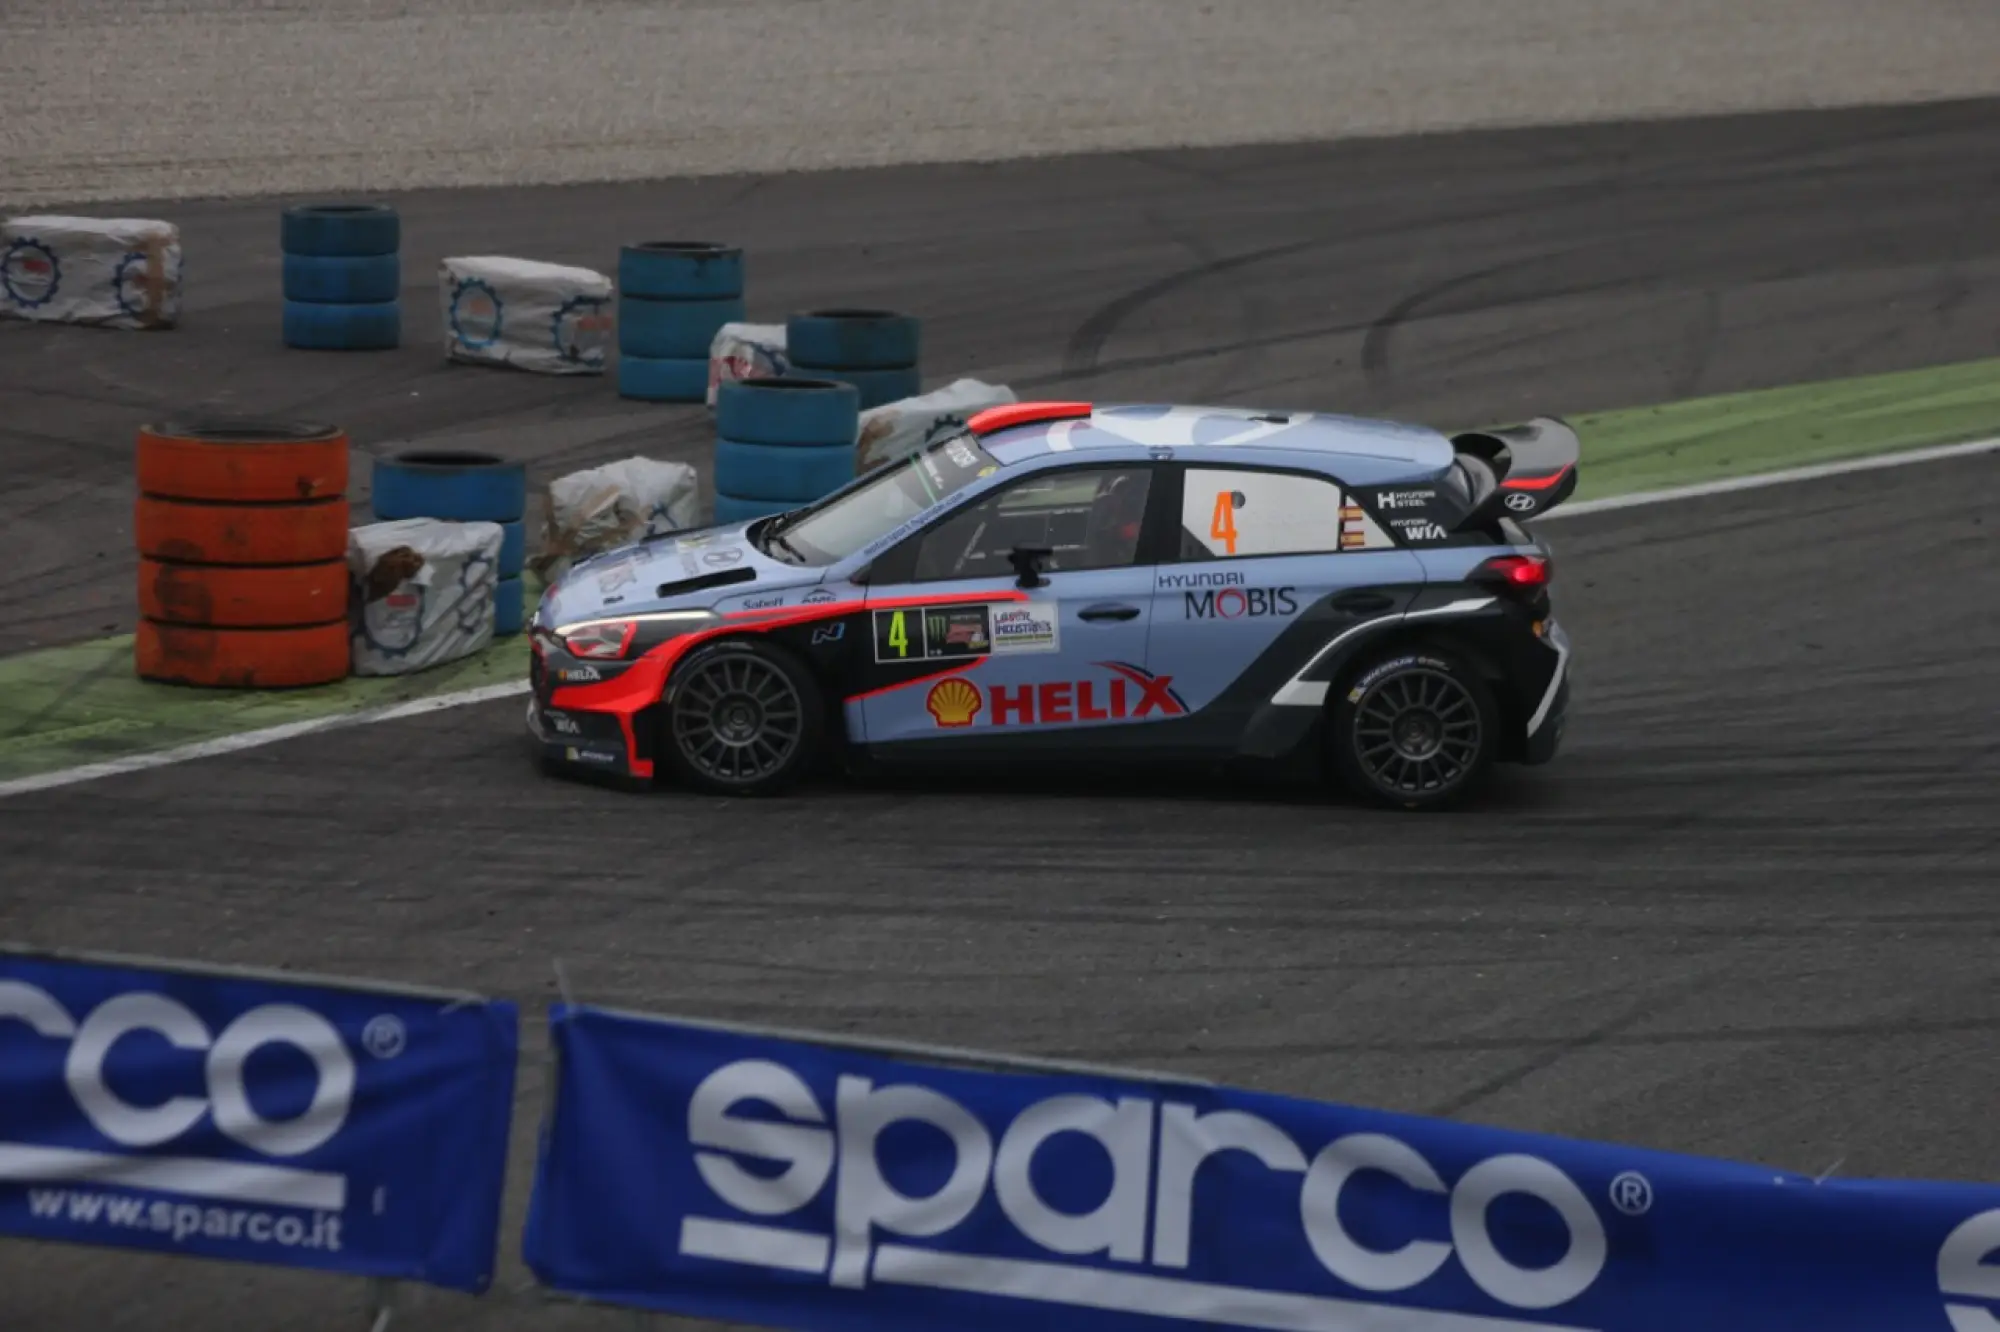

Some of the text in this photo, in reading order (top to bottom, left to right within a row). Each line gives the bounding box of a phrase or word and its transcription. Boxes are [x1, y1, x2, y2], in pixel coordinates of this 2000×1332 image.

[1396, 490, 1436, 499] HYUNDAI
[1210, 490, 1238, 555] 4
[1390, 518, 1428, 527] HYUNDAI
[1158, 572, 1245, 588] HYUNDAI
[1184, 586, 1298, 620] MOBIS
[888, 610, 908, 657] 4
[987, 670, 1186, 725] HELIX
[687, 1058, 1607, 1310] sparco
[28, 1188, 342, 1252] www.sparco.it
